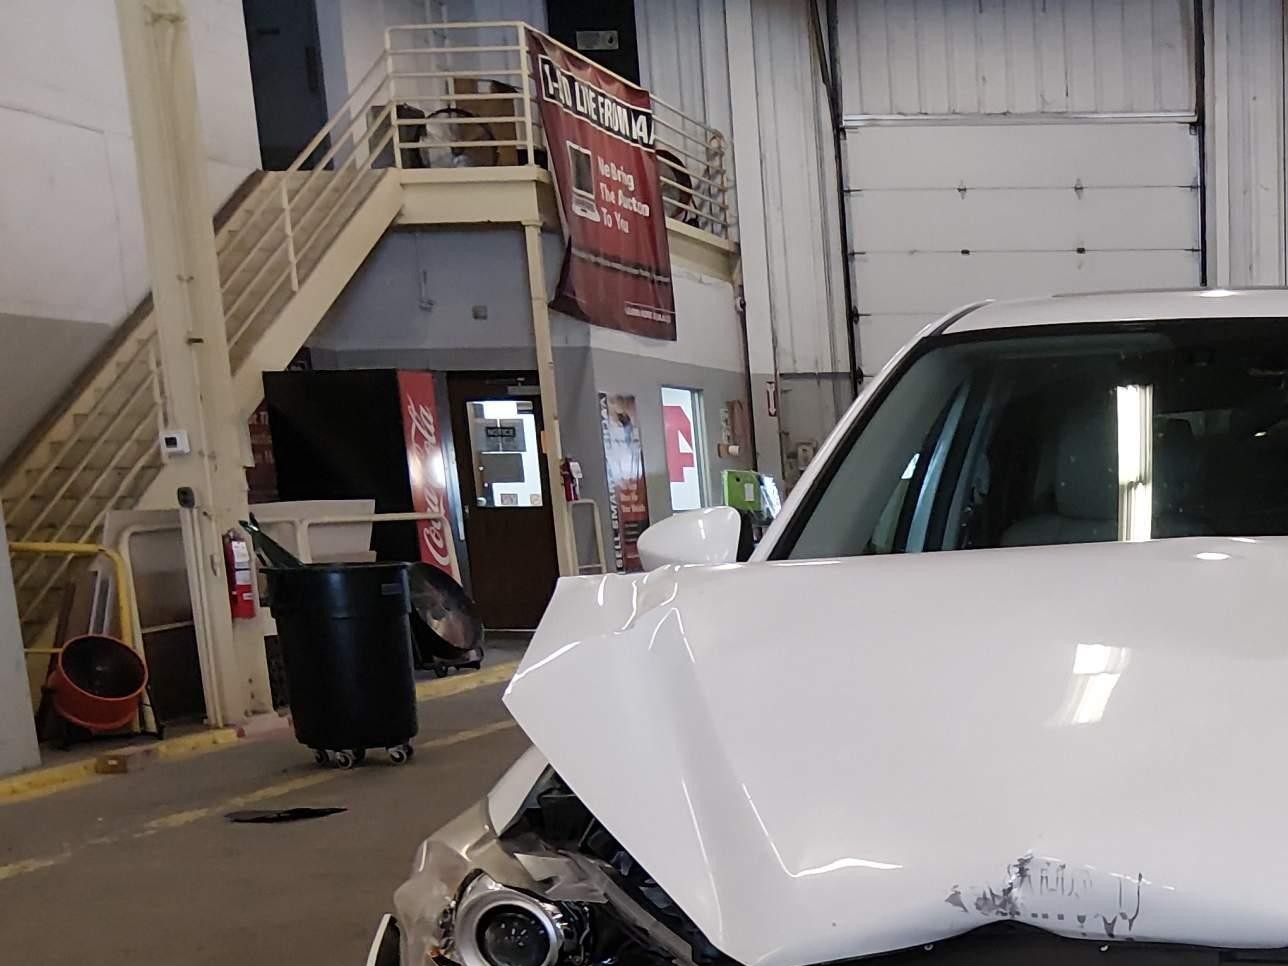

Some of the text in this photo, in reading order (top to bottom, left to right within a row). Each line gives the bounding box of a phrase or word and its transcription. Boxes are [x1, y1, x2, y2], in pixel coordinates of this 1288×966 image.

[598, 95, 631, 137] FROM
[407, 393, 451, 566] Cocaola
[607, 480, 620, 530] SMAR
